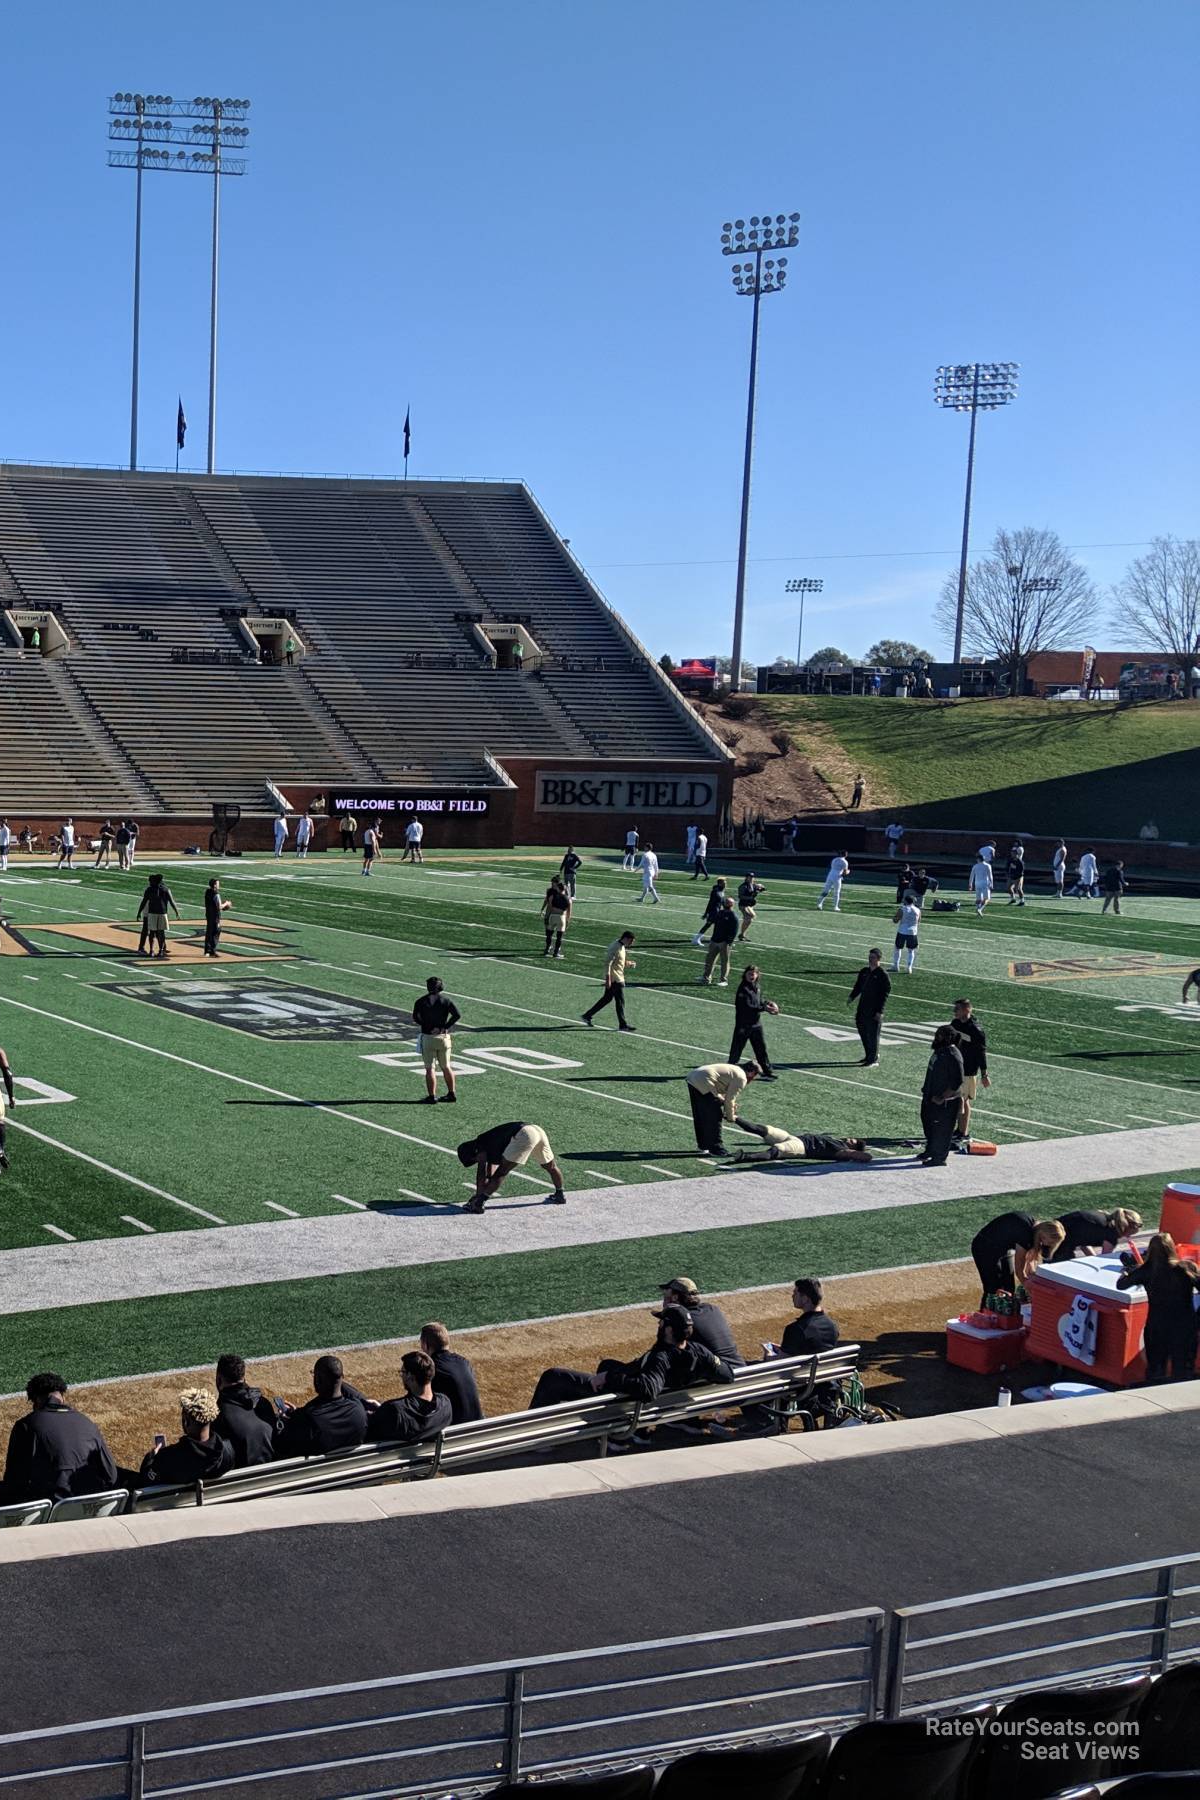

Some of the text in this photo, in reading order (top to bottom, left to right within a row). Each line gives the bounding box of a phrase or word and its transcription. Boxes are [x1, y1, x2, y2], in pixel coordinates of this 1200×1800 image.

[541, 779, 713, 808] BB&T FIELD
[335, 798, 487, 812] WELCOME TO BB&T FIELD
